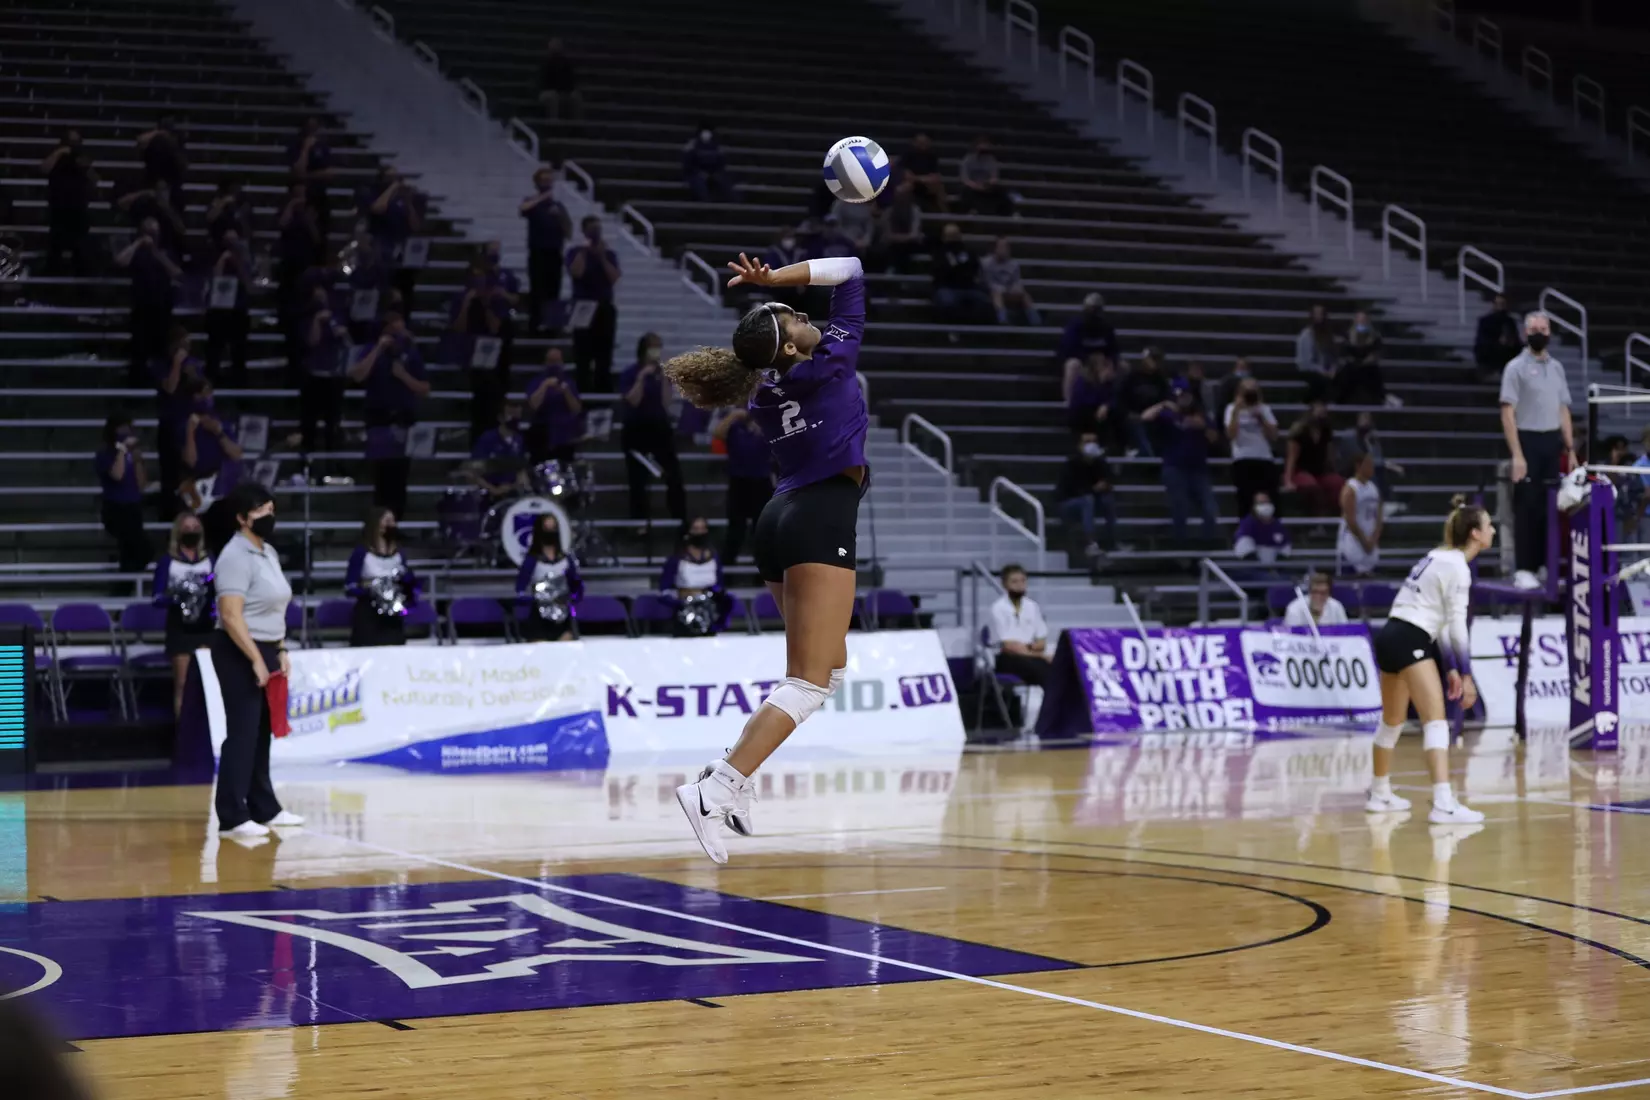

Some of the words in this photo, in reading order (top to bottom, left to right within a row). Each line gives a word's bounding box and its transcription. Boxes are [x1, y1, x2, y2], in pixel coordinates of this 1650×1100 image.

[778, 400, 807, 434] 2
[1571, 528, 1591, 706] K-STATE
[1121, 634, 1230, 671] DRIVE
[481, 664, 541, 684] Made
[1129, 668, 1227, 702] WITH
[1139, 698, 1258, 730] PRIDE!
